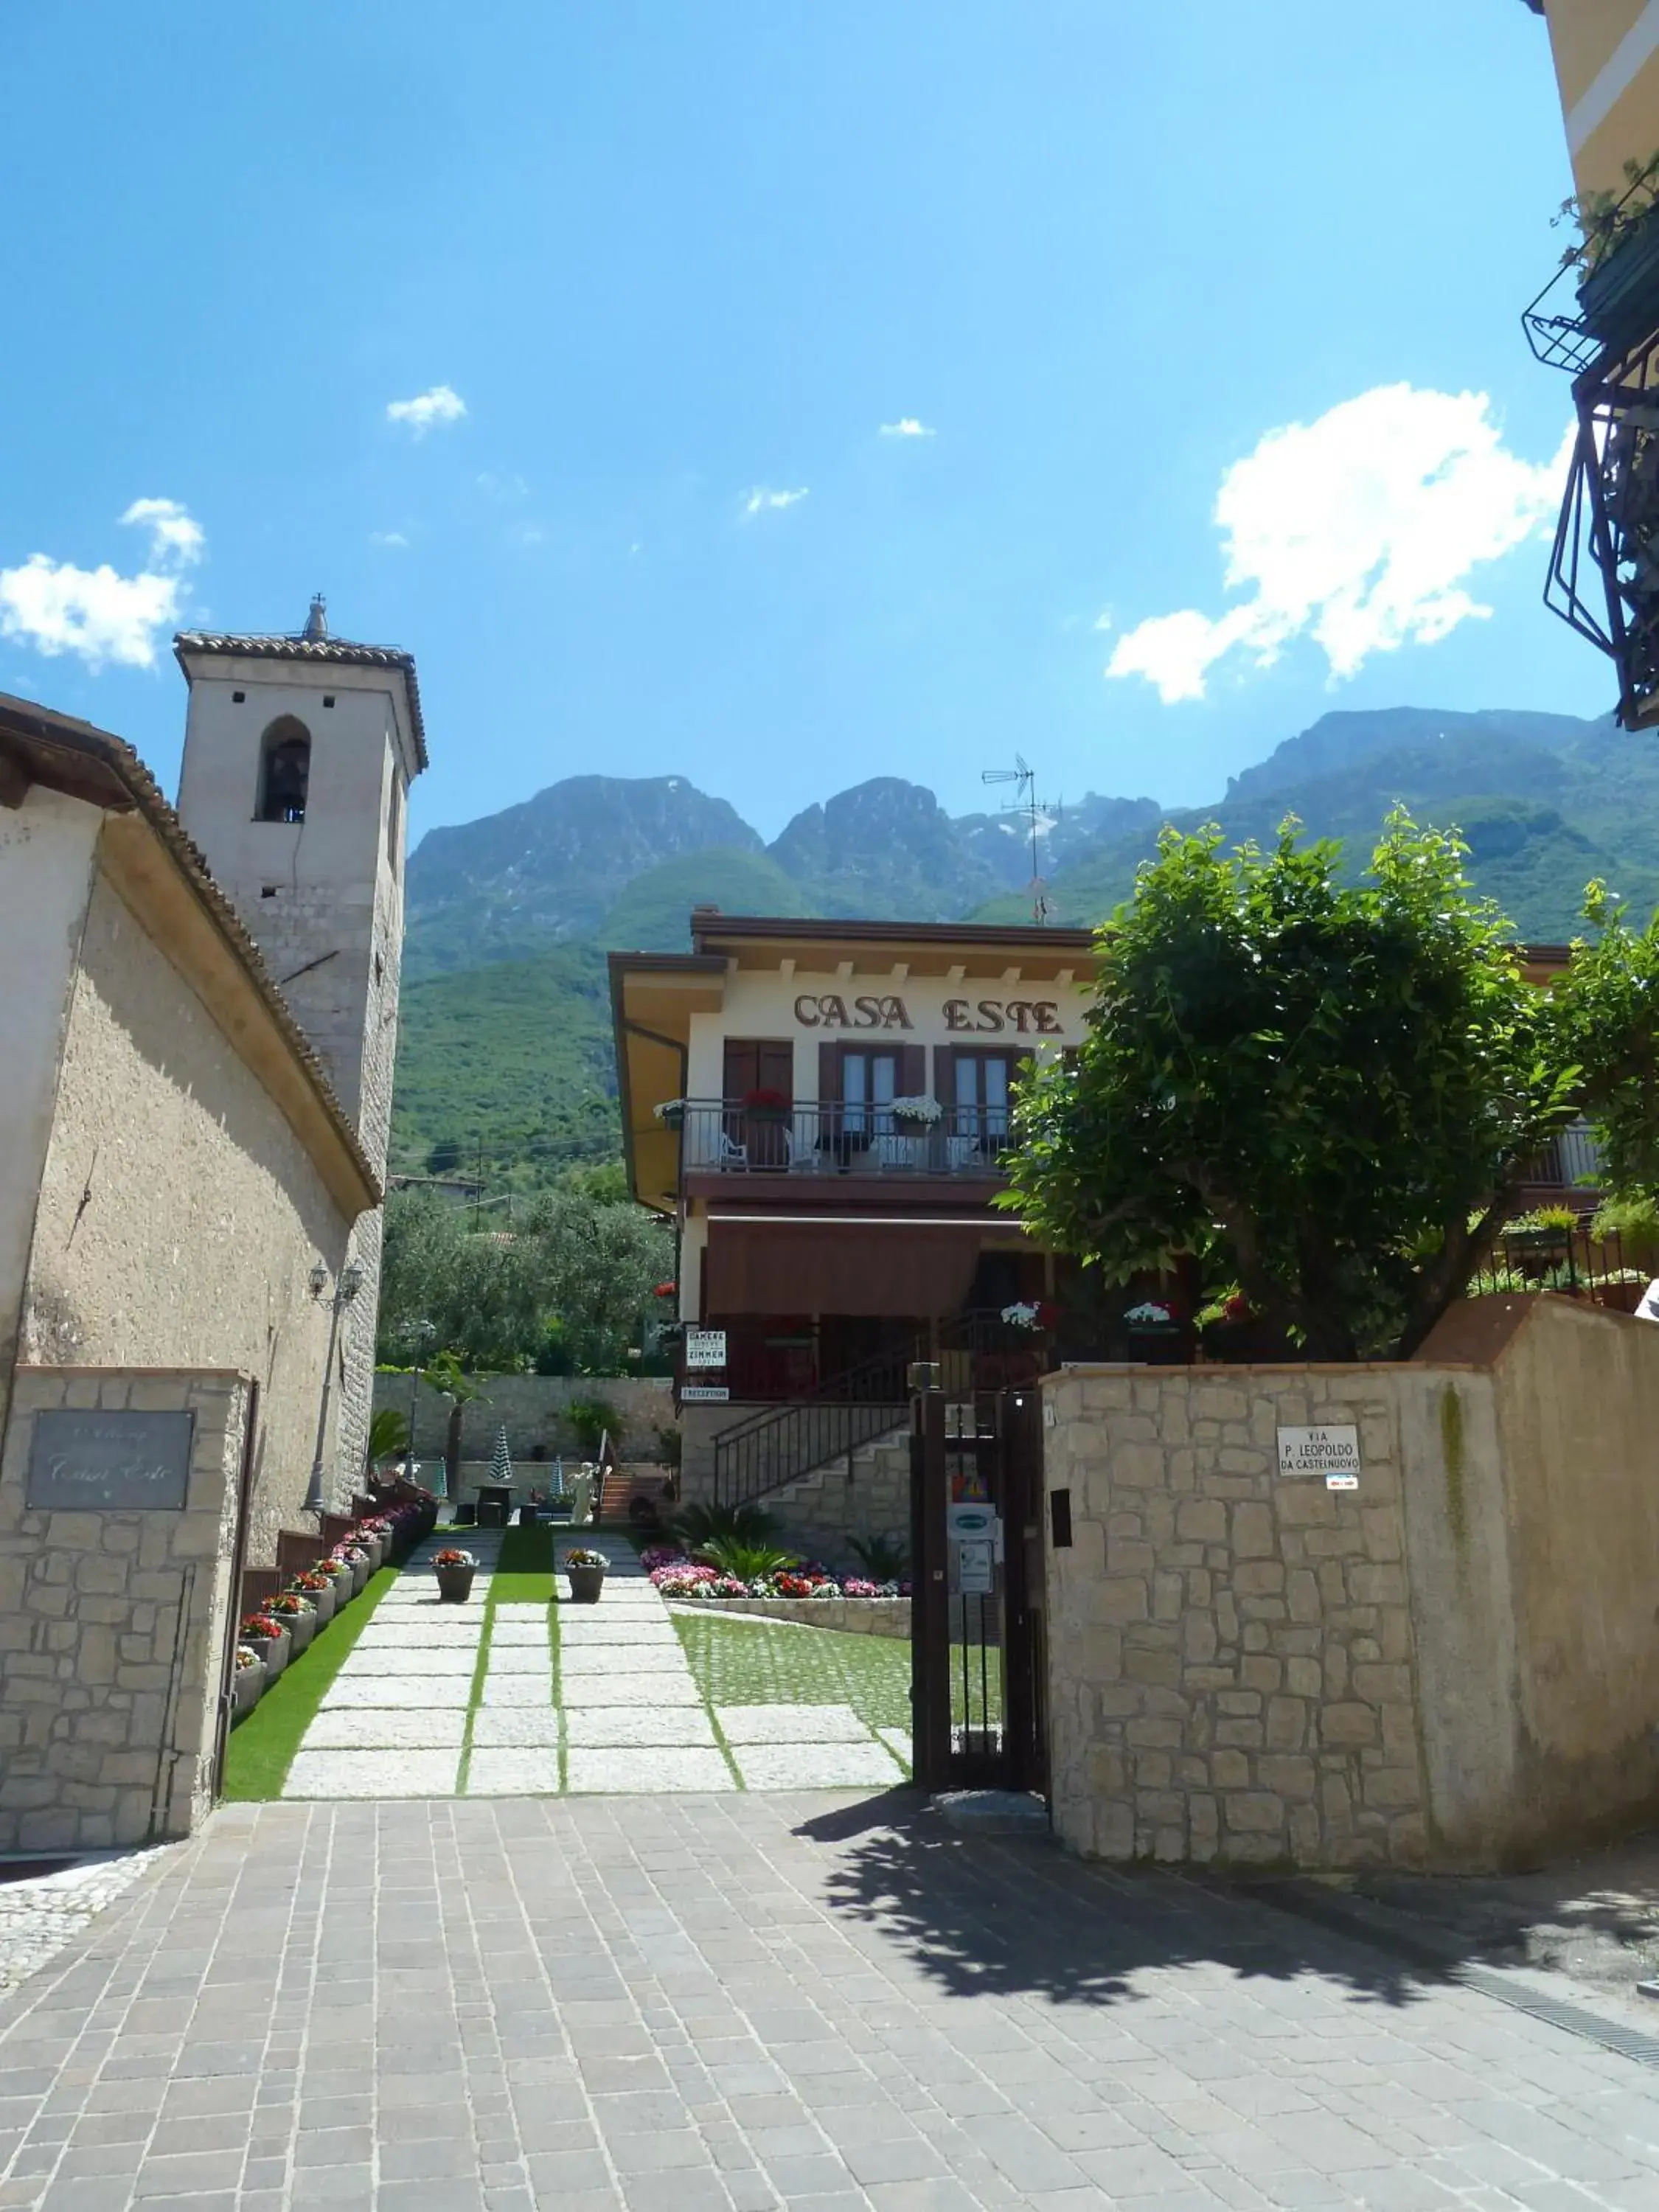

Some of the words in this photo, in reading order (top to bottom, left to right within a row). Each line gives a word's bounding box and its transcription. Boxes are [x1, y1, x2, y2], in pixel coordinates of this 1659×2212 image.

[794, 995, 914, 1029] CASA
[942, 999, 1065, 1034] ESTE
[689, 1350, 723, 1359] ZIMMER
[1308, 1431, 1327, 1441] VIA
[1285, 1445, 1295, 1457] P.
[1299, 1444, 1353, 1457] LEOPOLDO
[1281, 1460, 1294, 1470] DA
[1295, 1458, 1359, 1470] CASTELNUOVO
